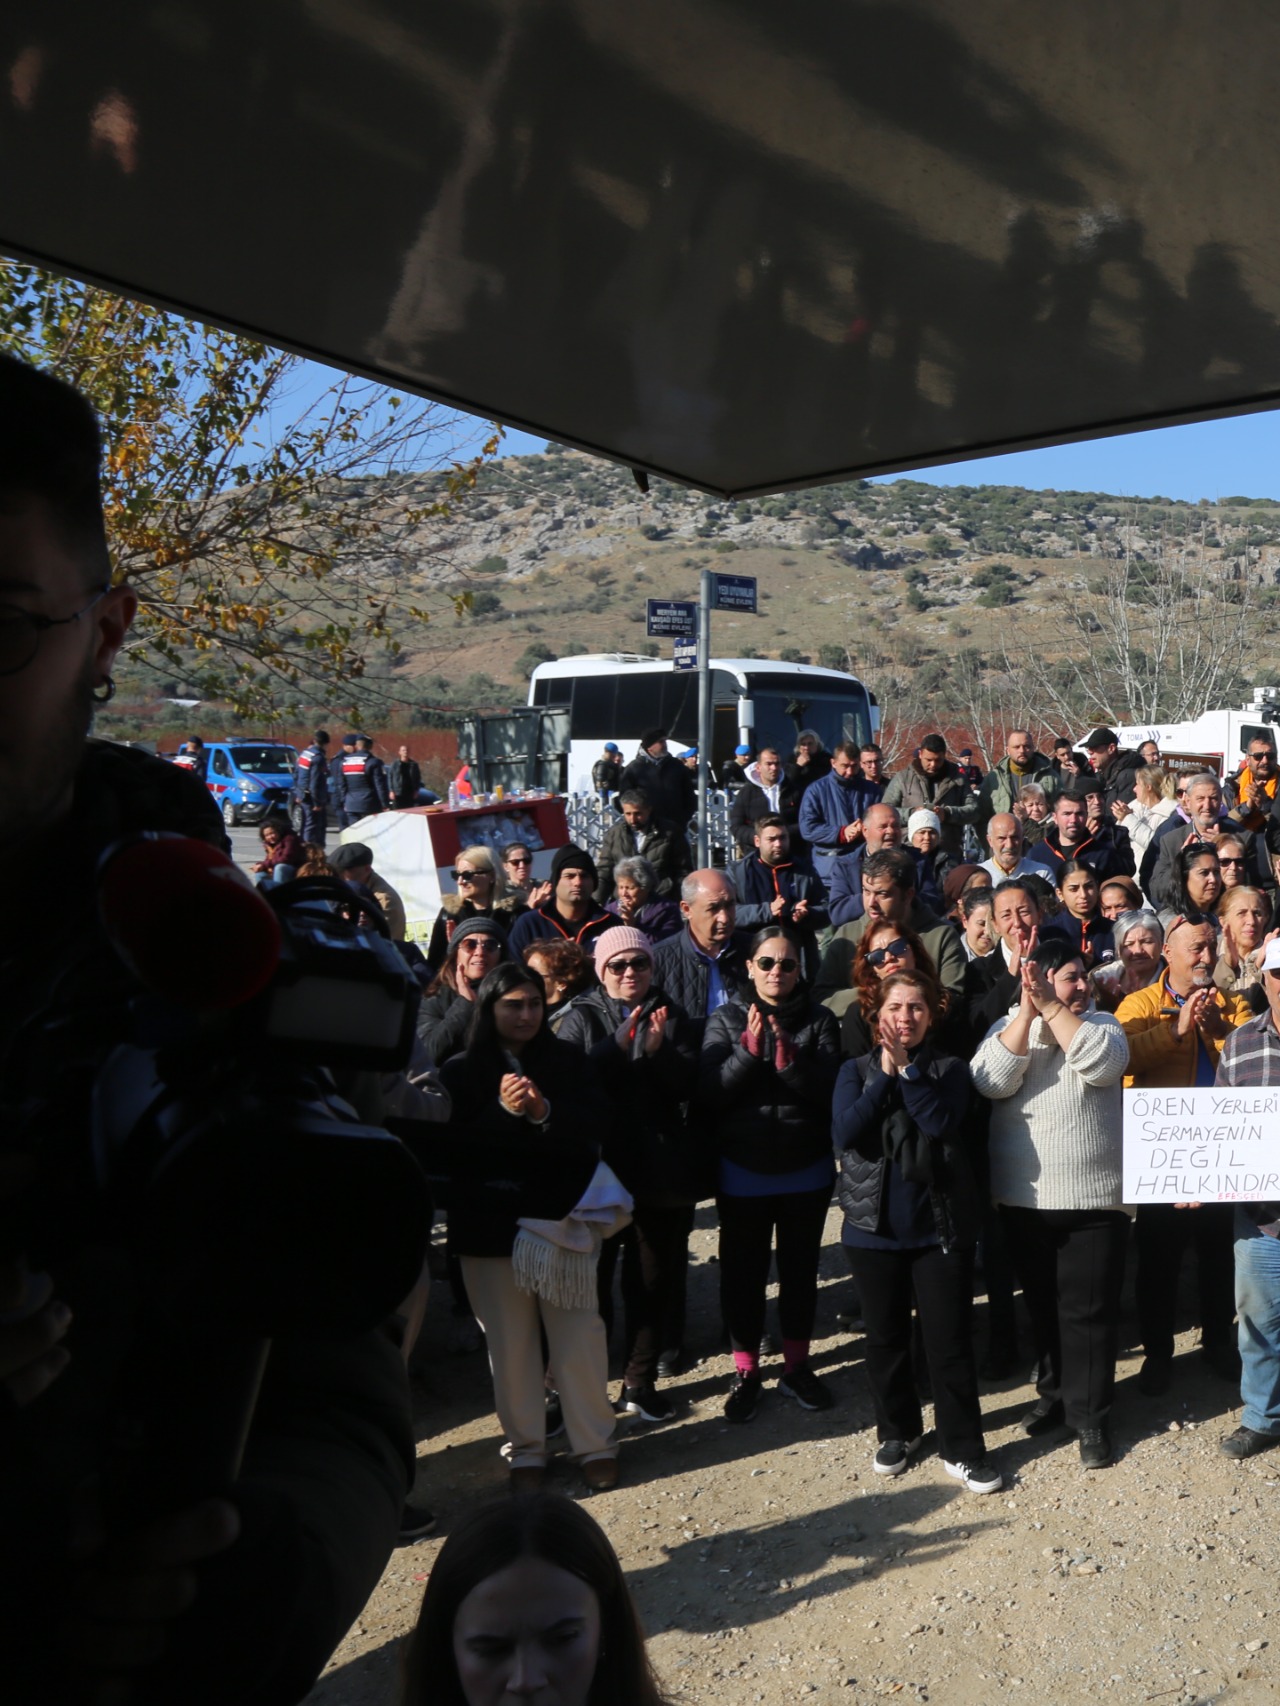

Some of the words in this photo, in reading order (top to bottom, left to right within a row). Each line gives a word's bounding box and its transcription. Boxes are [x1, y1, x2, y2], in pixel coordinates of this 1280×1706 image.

[1132, 1091, 1195, 1117] ÖREN
[1211, 1092, 1278, 1115] YERLERİ
[1141, 1117, 1262, 1142] SERMAYENİN
[1150, 1143, 1245, 1169] DEĞİL
